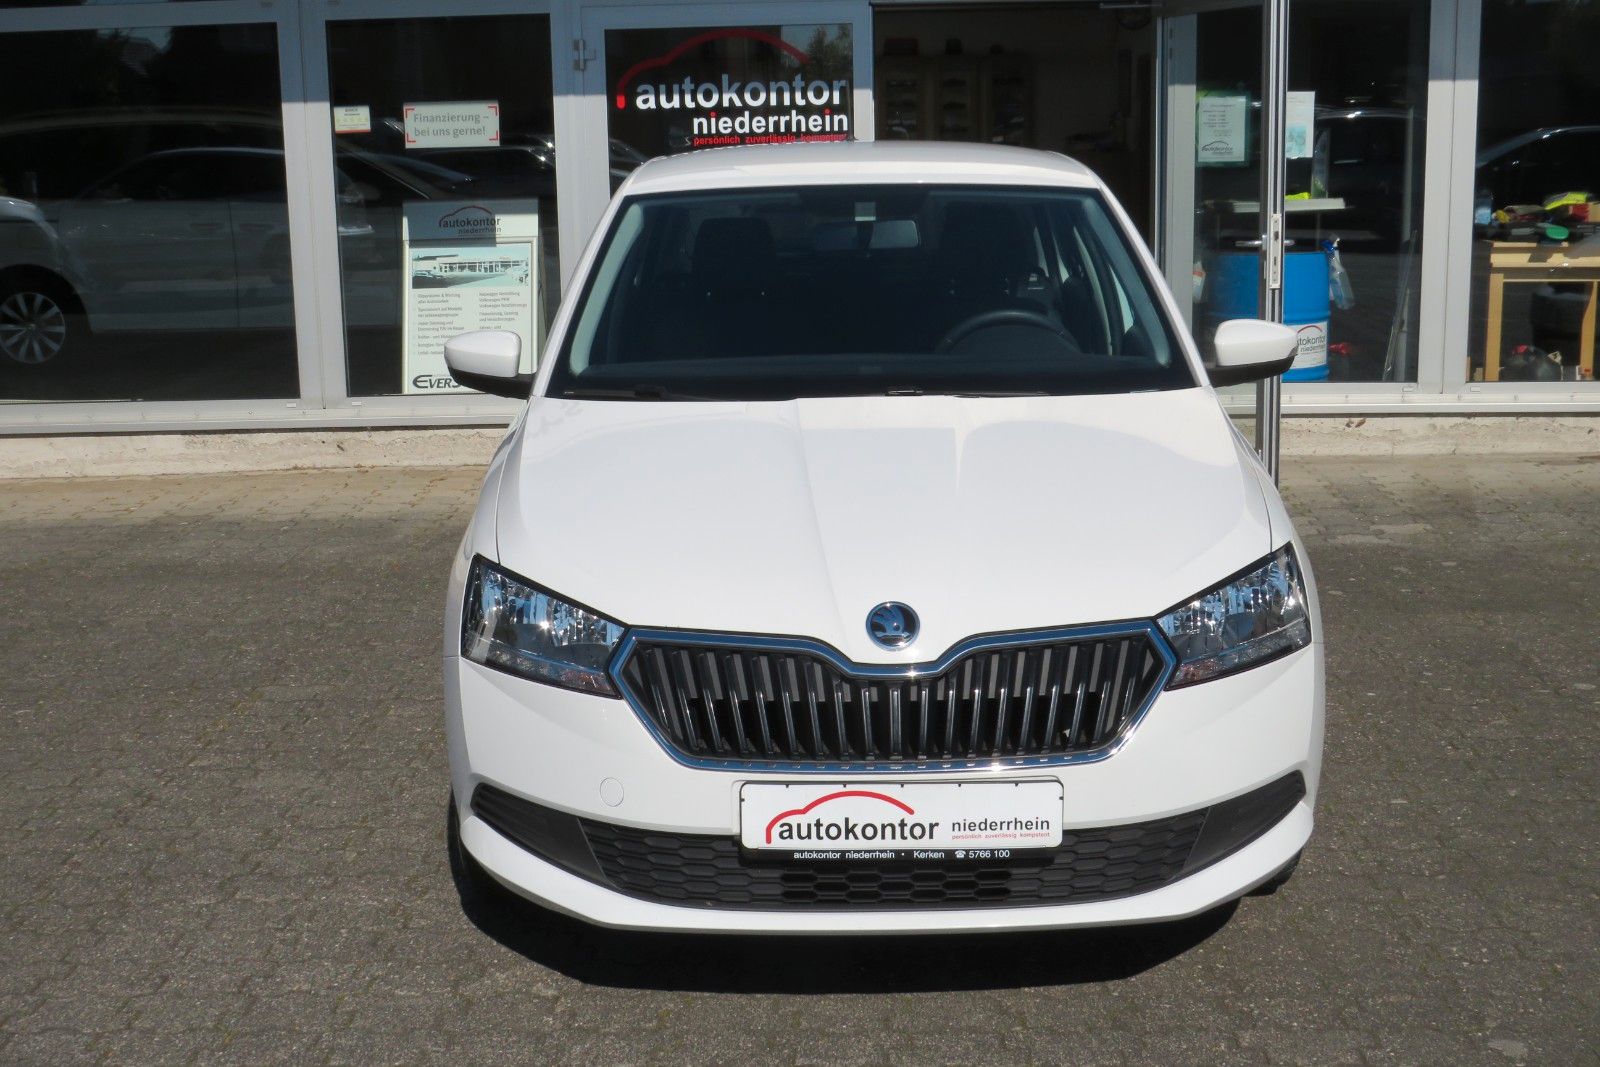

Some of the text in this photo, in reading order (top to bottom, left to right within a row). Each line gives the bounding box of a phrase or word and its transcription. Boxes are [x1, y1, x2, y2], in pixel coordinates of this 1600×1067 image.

[636, 74, 847, 109] autokontor
[413, 112, 481, 124] Finanzierung
[693, 108, 848, 134] niederrhein
[414, 127, 486, 138] bei uns gerne!
[693, 135, 741, 146] persönlich
[443, 217, 501, 228] autokontor
[779, 817, 1050, 841] autokontor niederrhein
[794, 849, 1010, 859] autokontor niederrhein Kerken 5766 100
